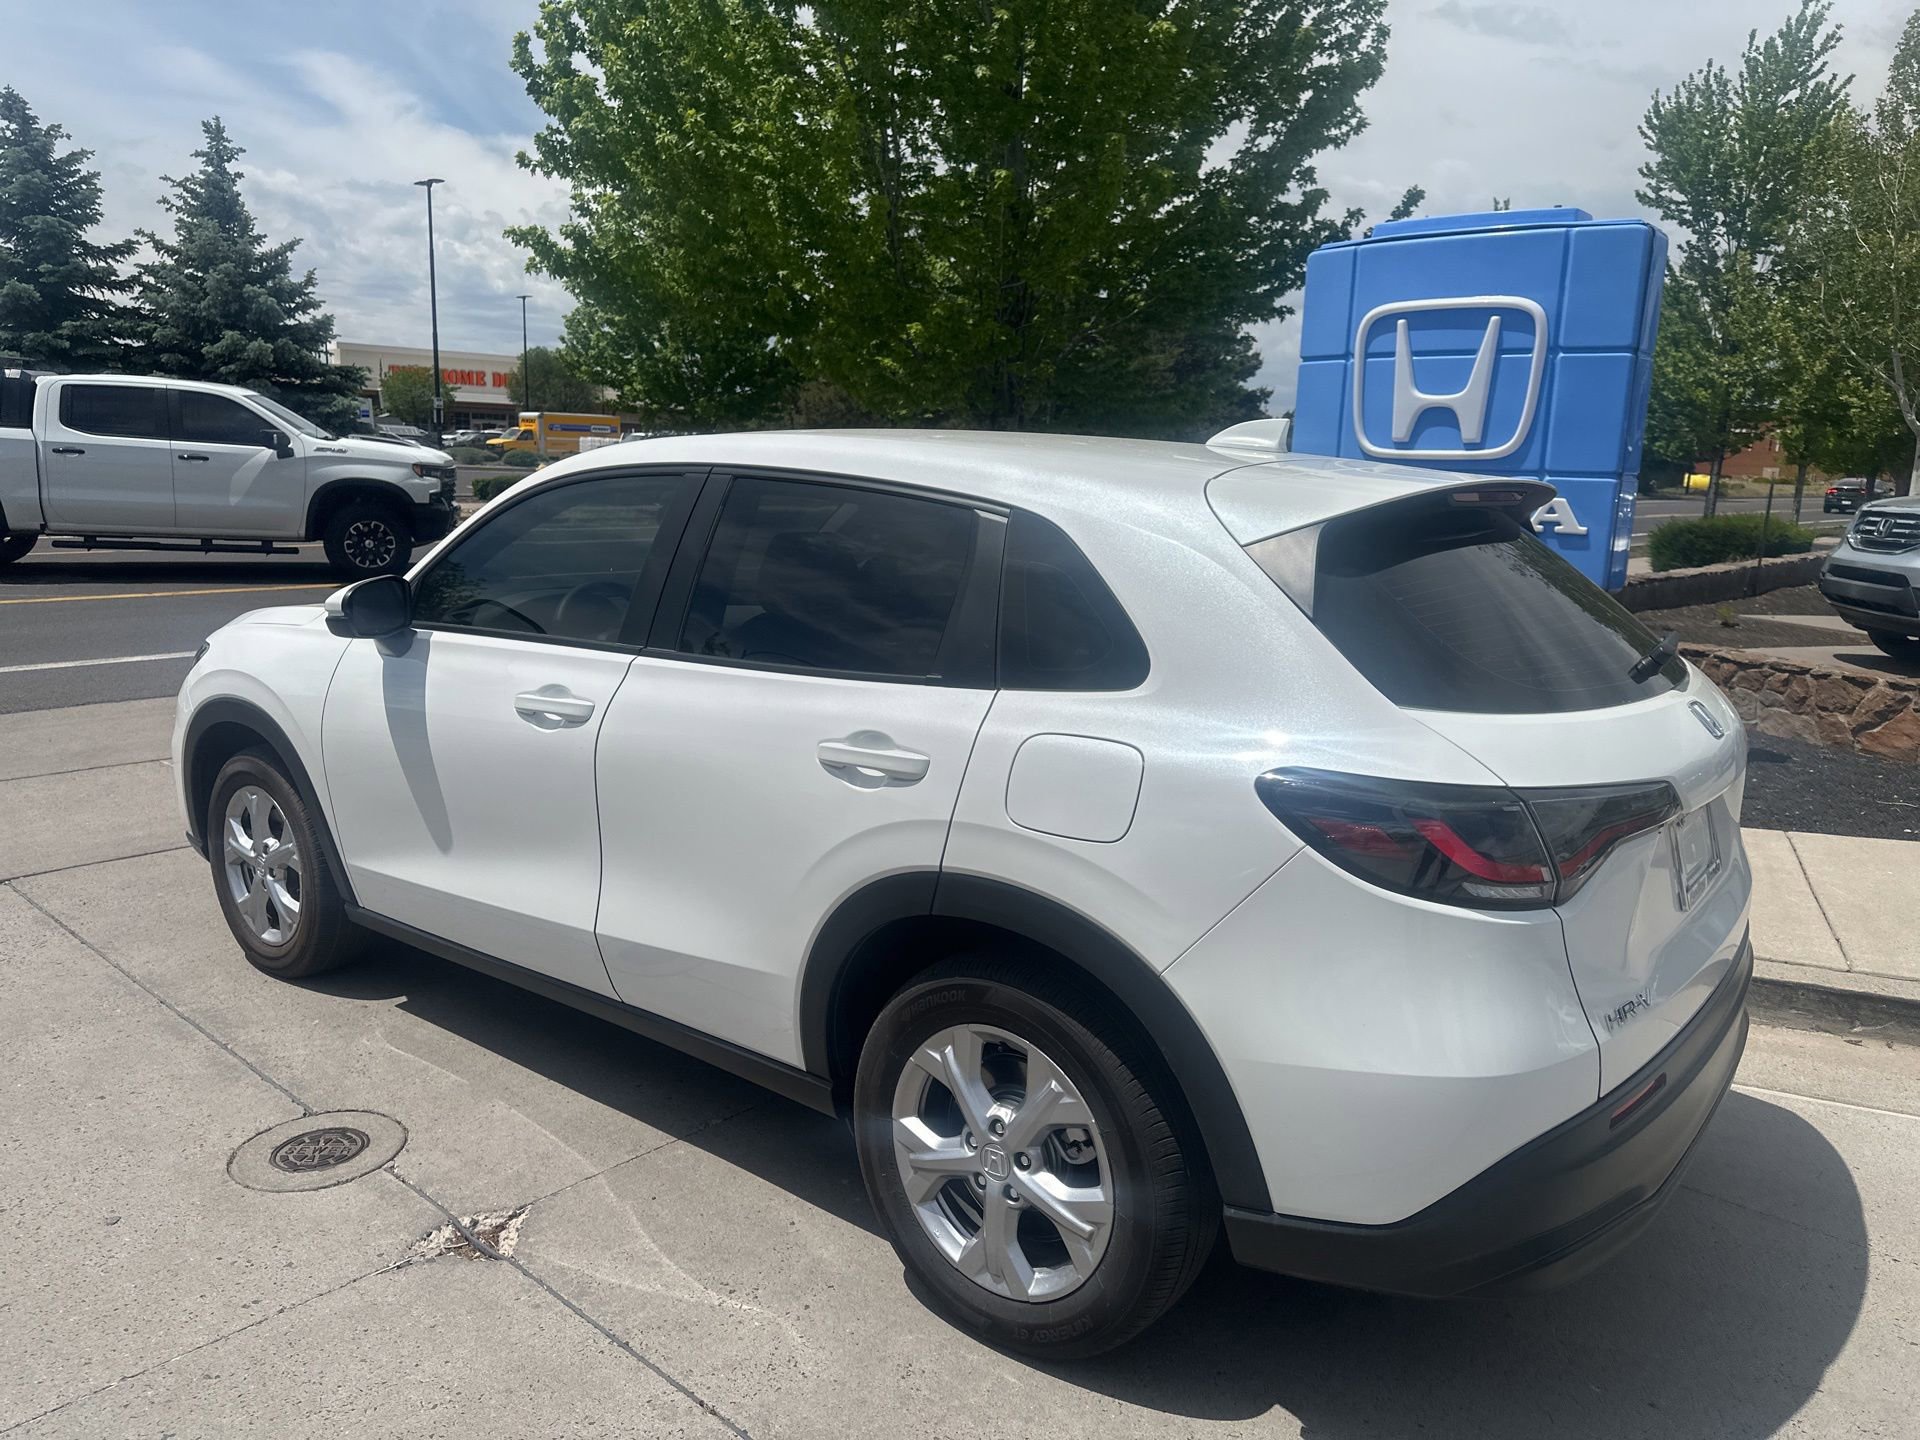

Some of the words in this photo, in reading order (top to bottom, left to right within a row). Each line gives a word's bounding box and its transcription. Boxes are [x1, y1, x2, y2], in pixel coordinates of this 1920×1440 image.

[440, 368, 487, 387] HOME
[1604, 987, 1651, 1032] HR-V
[285, 1146, 352, 1155] SEWER
